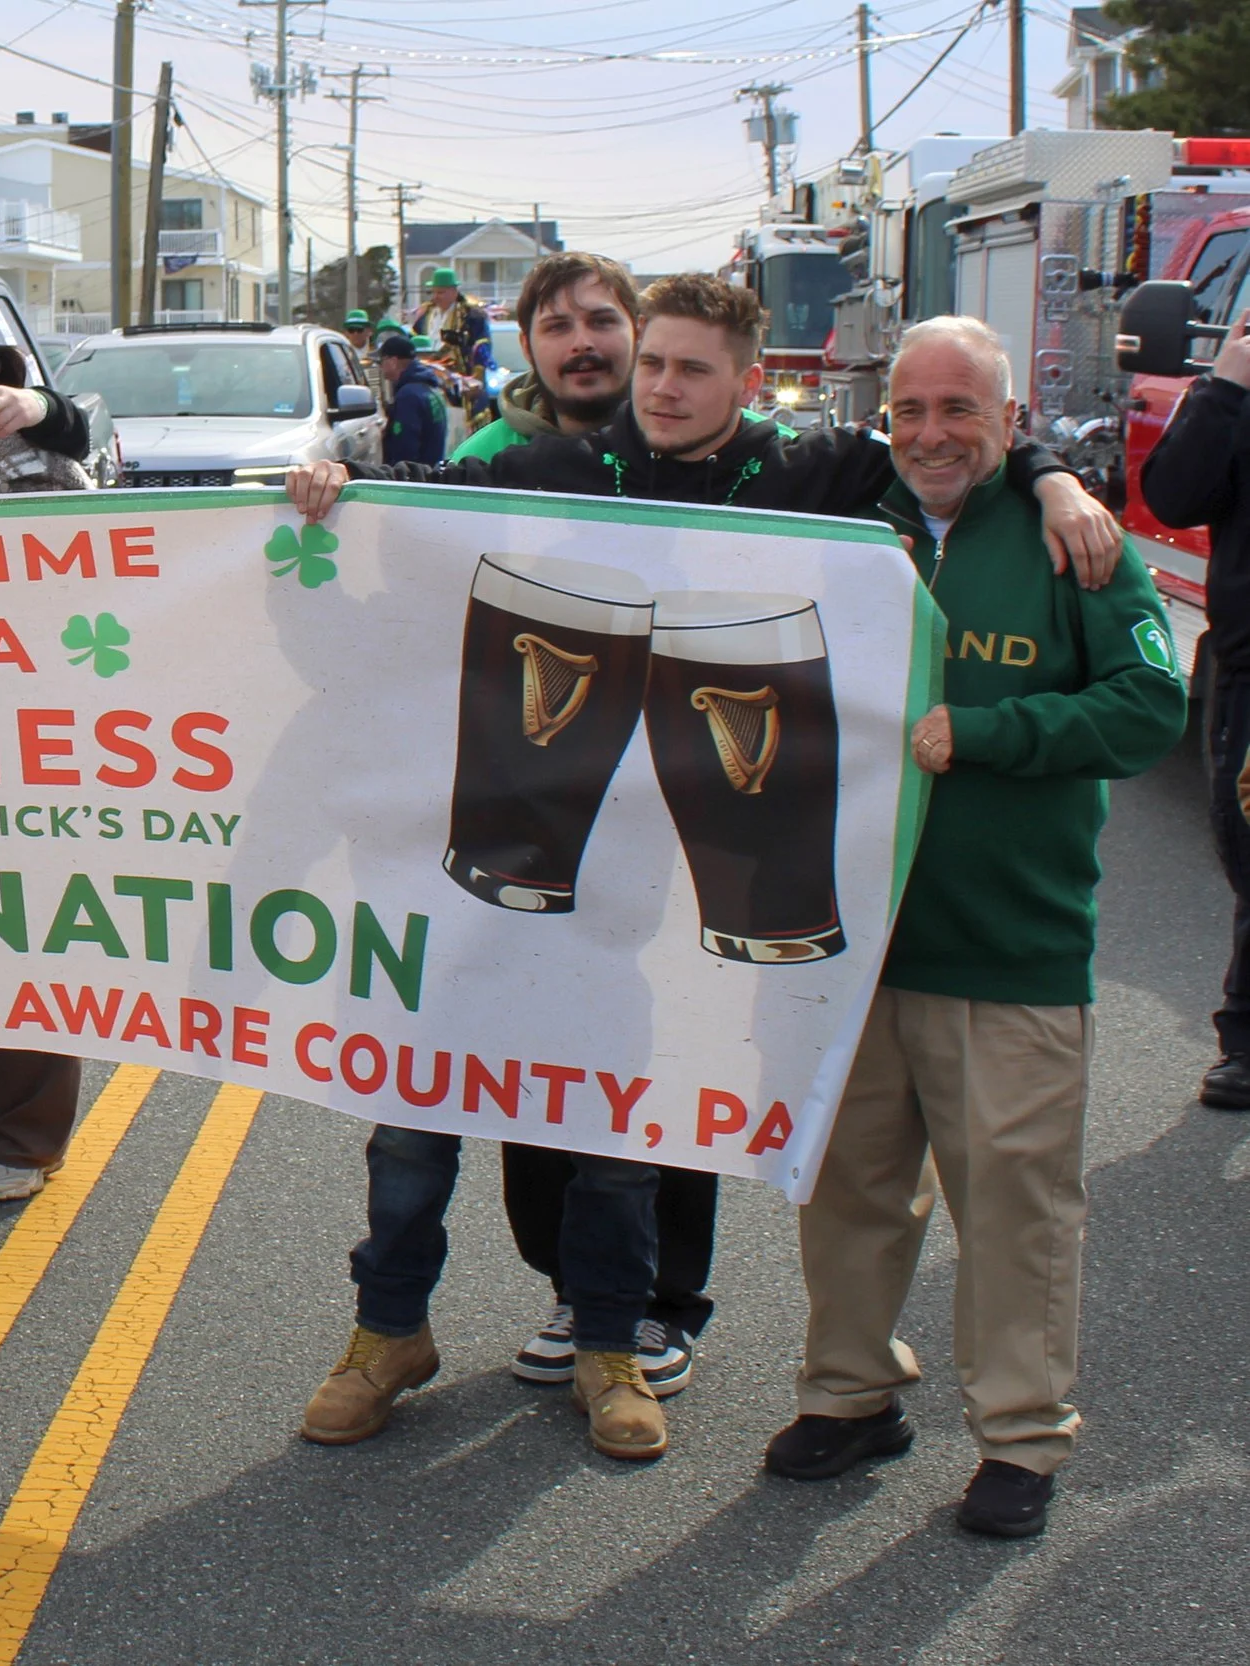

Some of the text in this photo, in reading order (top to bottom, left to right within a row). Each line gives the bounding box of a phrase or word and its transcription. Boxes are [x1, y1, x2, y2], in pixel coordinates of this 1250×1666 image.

[146, 810, 242, 847] DAY
[295, 1022, 663, 1148] COUNTY,
[696, 1087, 794, 1156] PA
